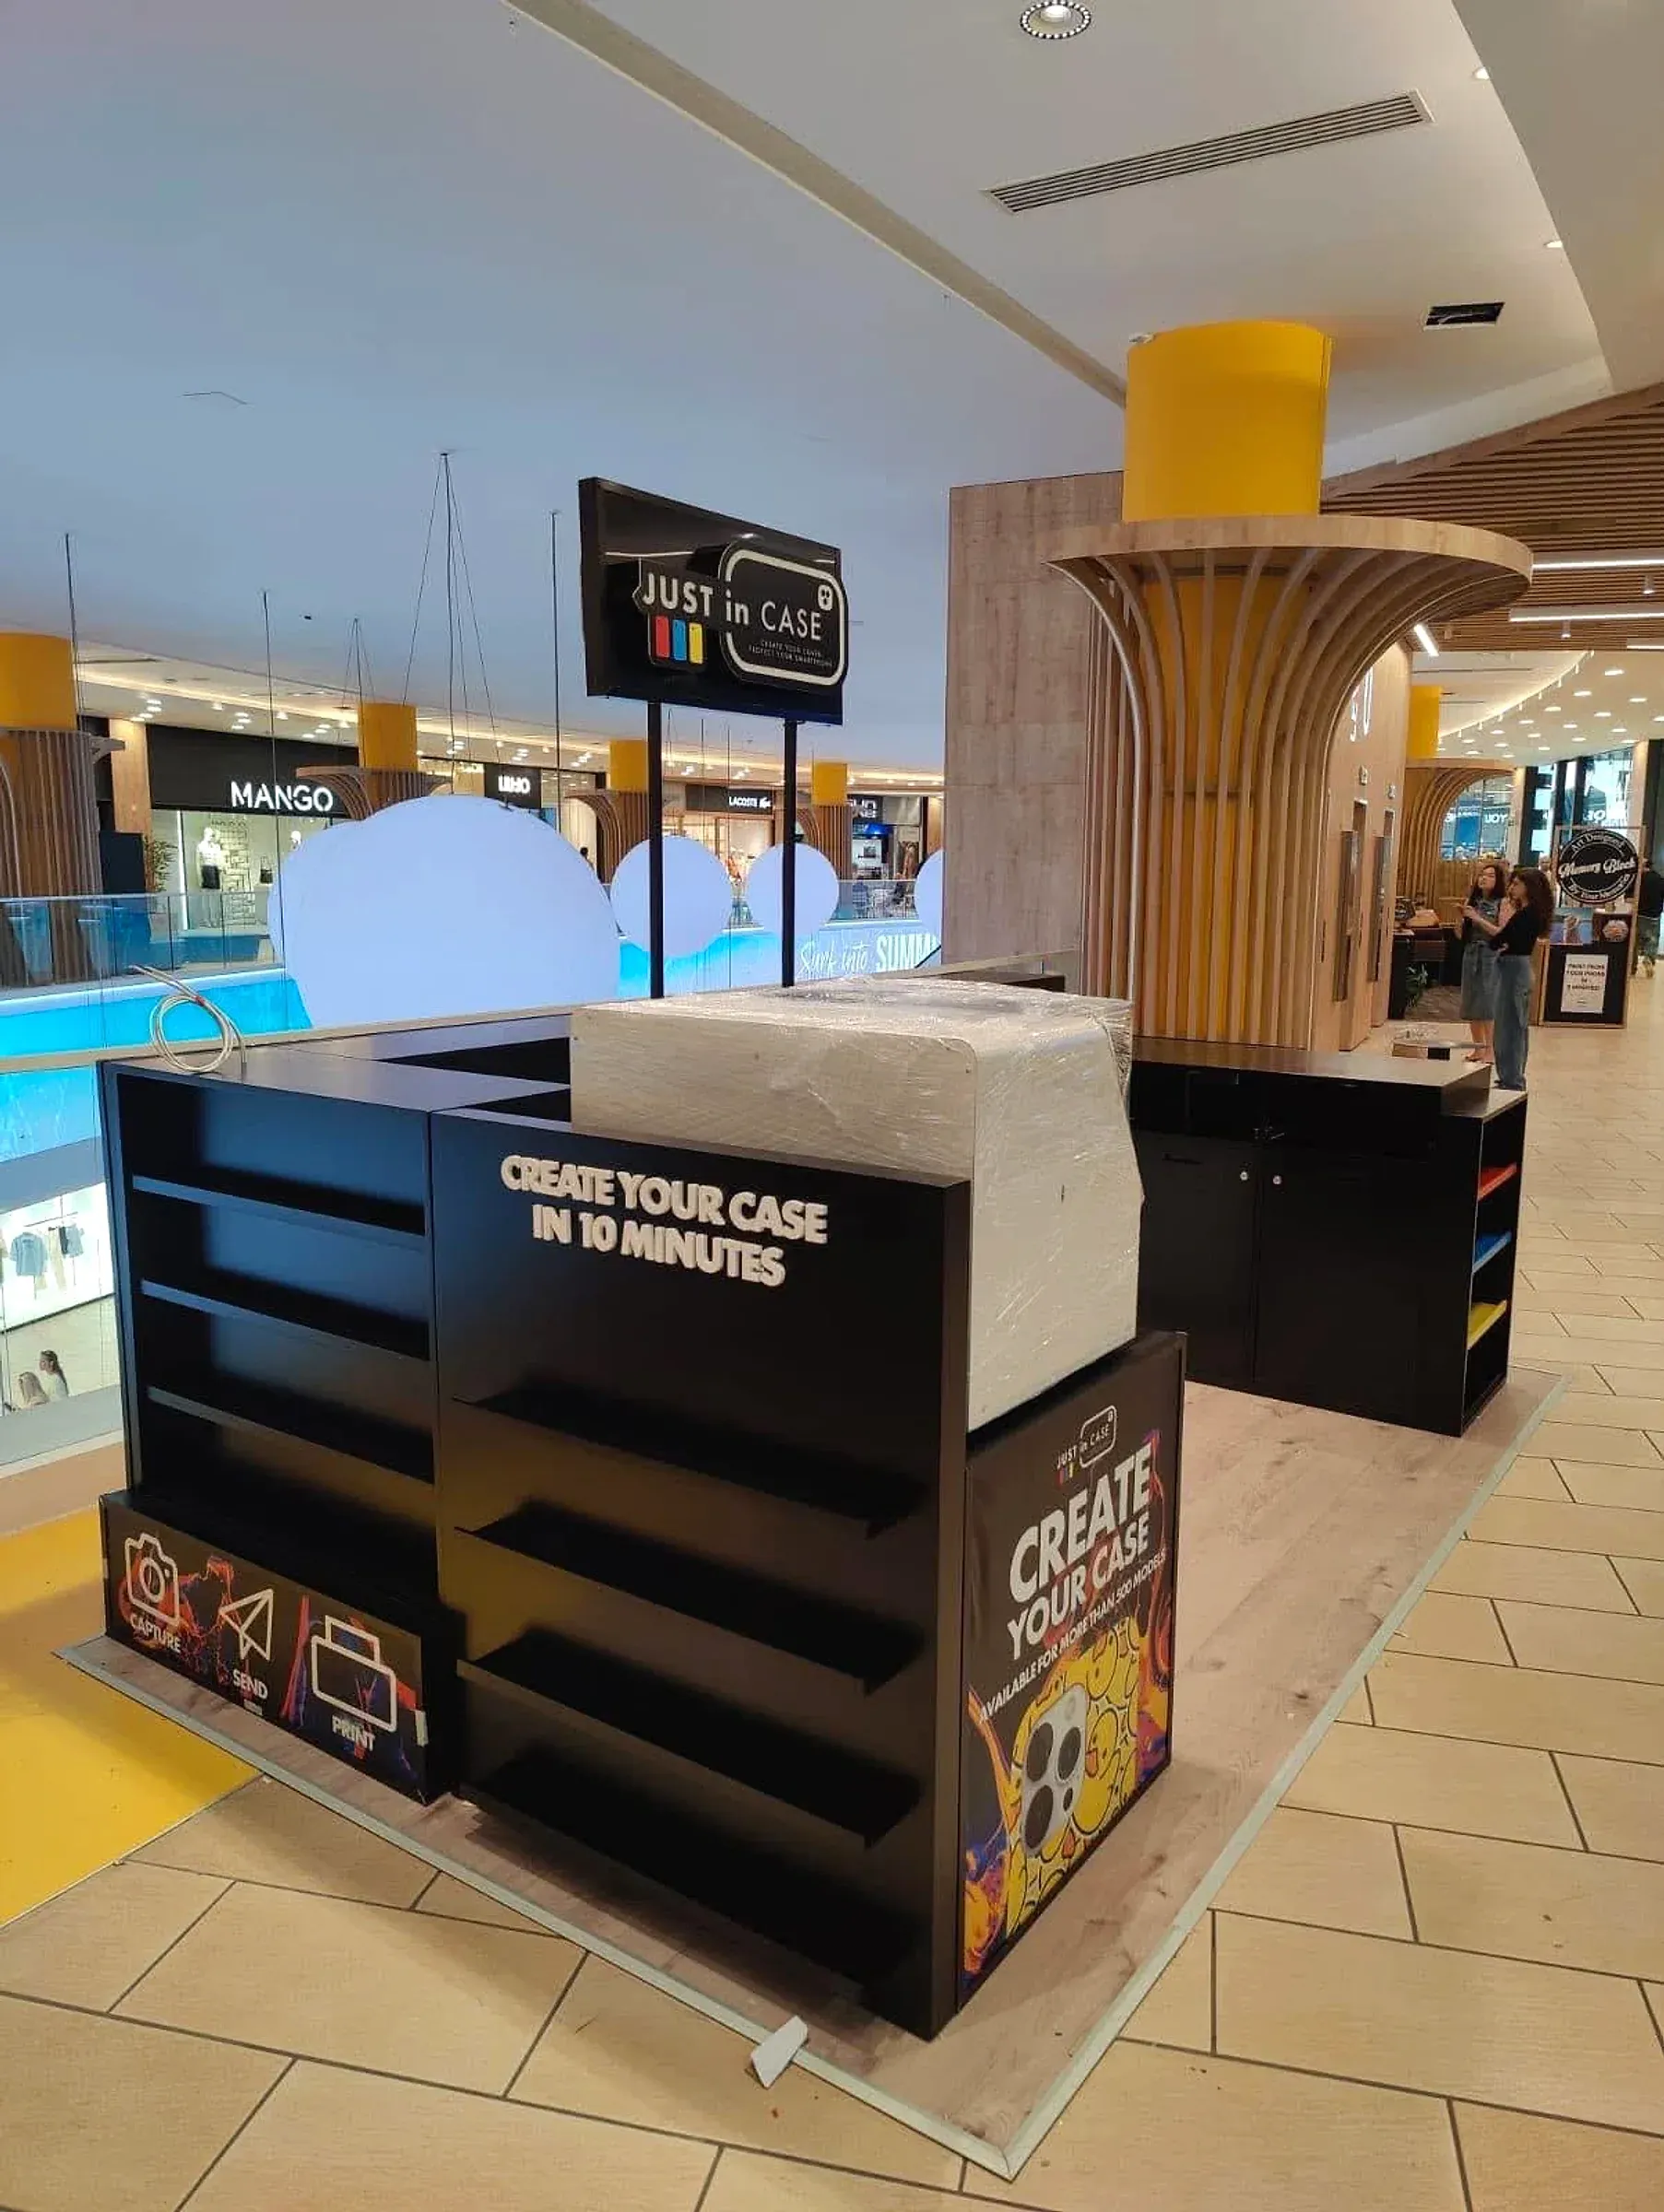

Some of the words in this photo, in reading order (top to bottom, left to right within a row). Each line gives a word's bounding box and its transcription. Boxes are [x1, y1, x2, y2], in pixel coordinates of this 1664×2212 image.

[642, 572, 714, 618] JUST
[726, 588, 749, 626] in
[761, 600, 822, 641] CASE
[230, 780, 334, 812] MANGO
[501, 1155, 615, 1206] CREATE
[617, 1171, 726, 1226] YOUR
[728, 1192, 828, 1244] CASE
[532, 1204, 572, 1244] IN
[578, 1212, 619, 1253] 10
[620, 1220, 786, 1288] MINUTES
[1056, 1445, 1078, 1471] JUST
[1090, 1423, 1110, 1446] CASE
[1009, 1441, 1152, 1604] CREATE
[1007, 1564, 1087, 1660] YOUR
[1092, 1511, 1150, 1590] CASE
[129, 1614, 182, 1653] CAPTURE
[979, 1660, 1037, 1722] AVAILABLE
[1036, 1644, 1060, 1674] FOR
[1059, 1619, 1089, 1653] MORE
[1087, 1594, 1115, 1628] THAN
[1132, 1547, 1167, 1588] MODELS
[232, 1668, 269, 1700] SEND
[331, 1714, 376, 1751] PRINT
